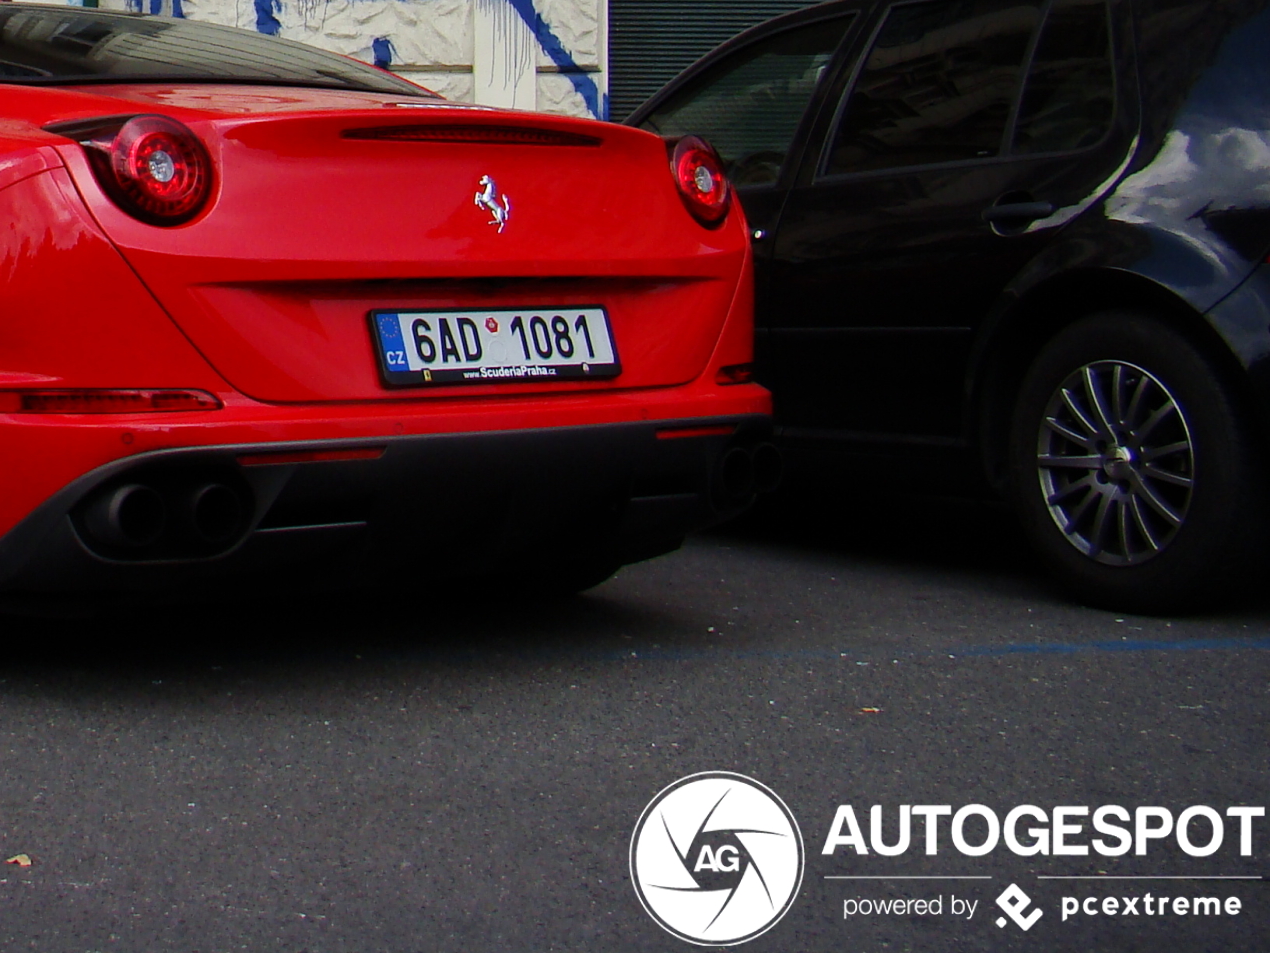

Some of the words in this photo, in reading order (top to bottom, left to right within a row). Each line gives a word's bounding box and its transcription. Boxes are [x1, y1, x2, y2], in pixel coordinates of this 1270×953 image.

[411, 316, 484, 364] 6AD
[510, 314, 596, 360] 1081
[386, 351, 406, 365] CZ
[463, 365, 557, 380] www.ScuderiaPraha.cz
